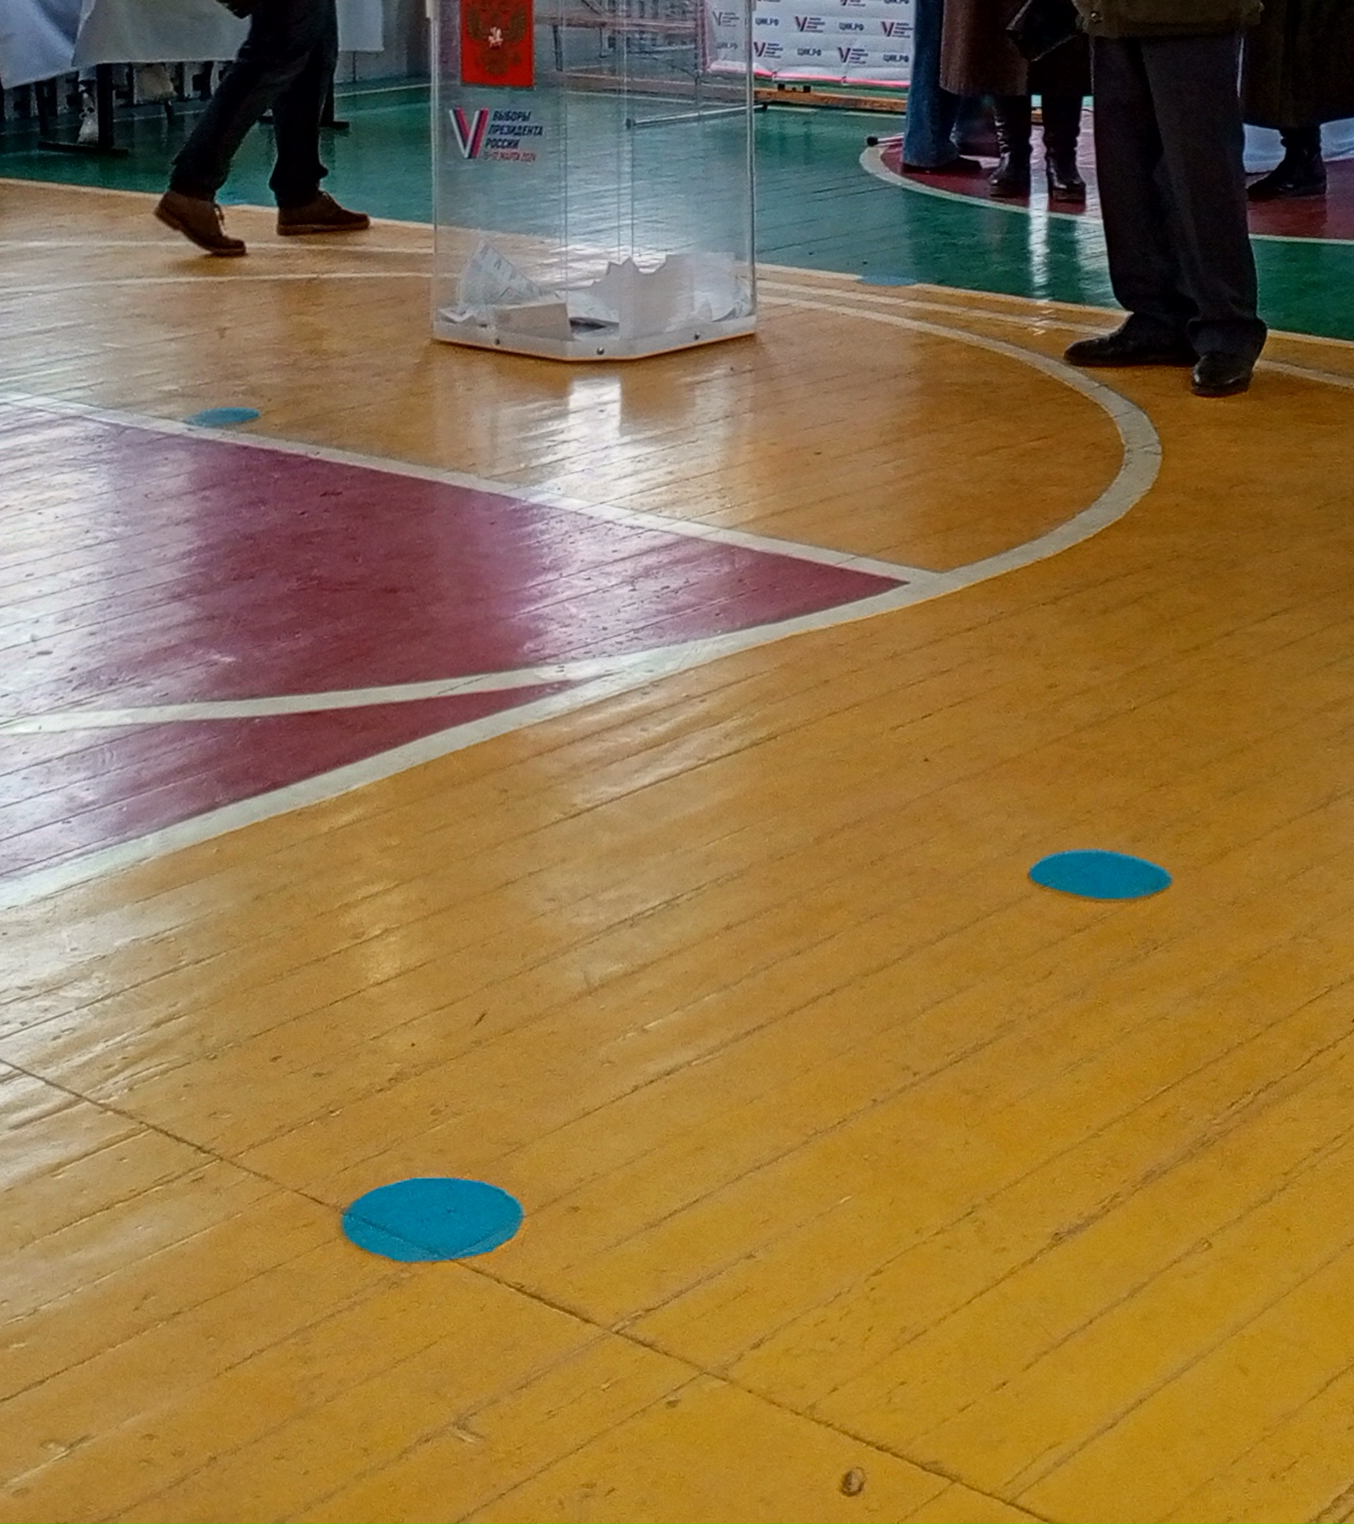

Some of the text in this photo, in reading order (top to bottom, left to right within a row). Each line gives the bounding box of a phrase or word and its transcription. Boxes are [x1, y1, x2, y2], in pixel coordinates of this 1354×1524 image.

[492, 110, 532, 122] ВЫБОРЫ
[488, 124, 543, 136] ПРЕЗИДЕНТА
[485, 138, 521, 149] РОССИИ
